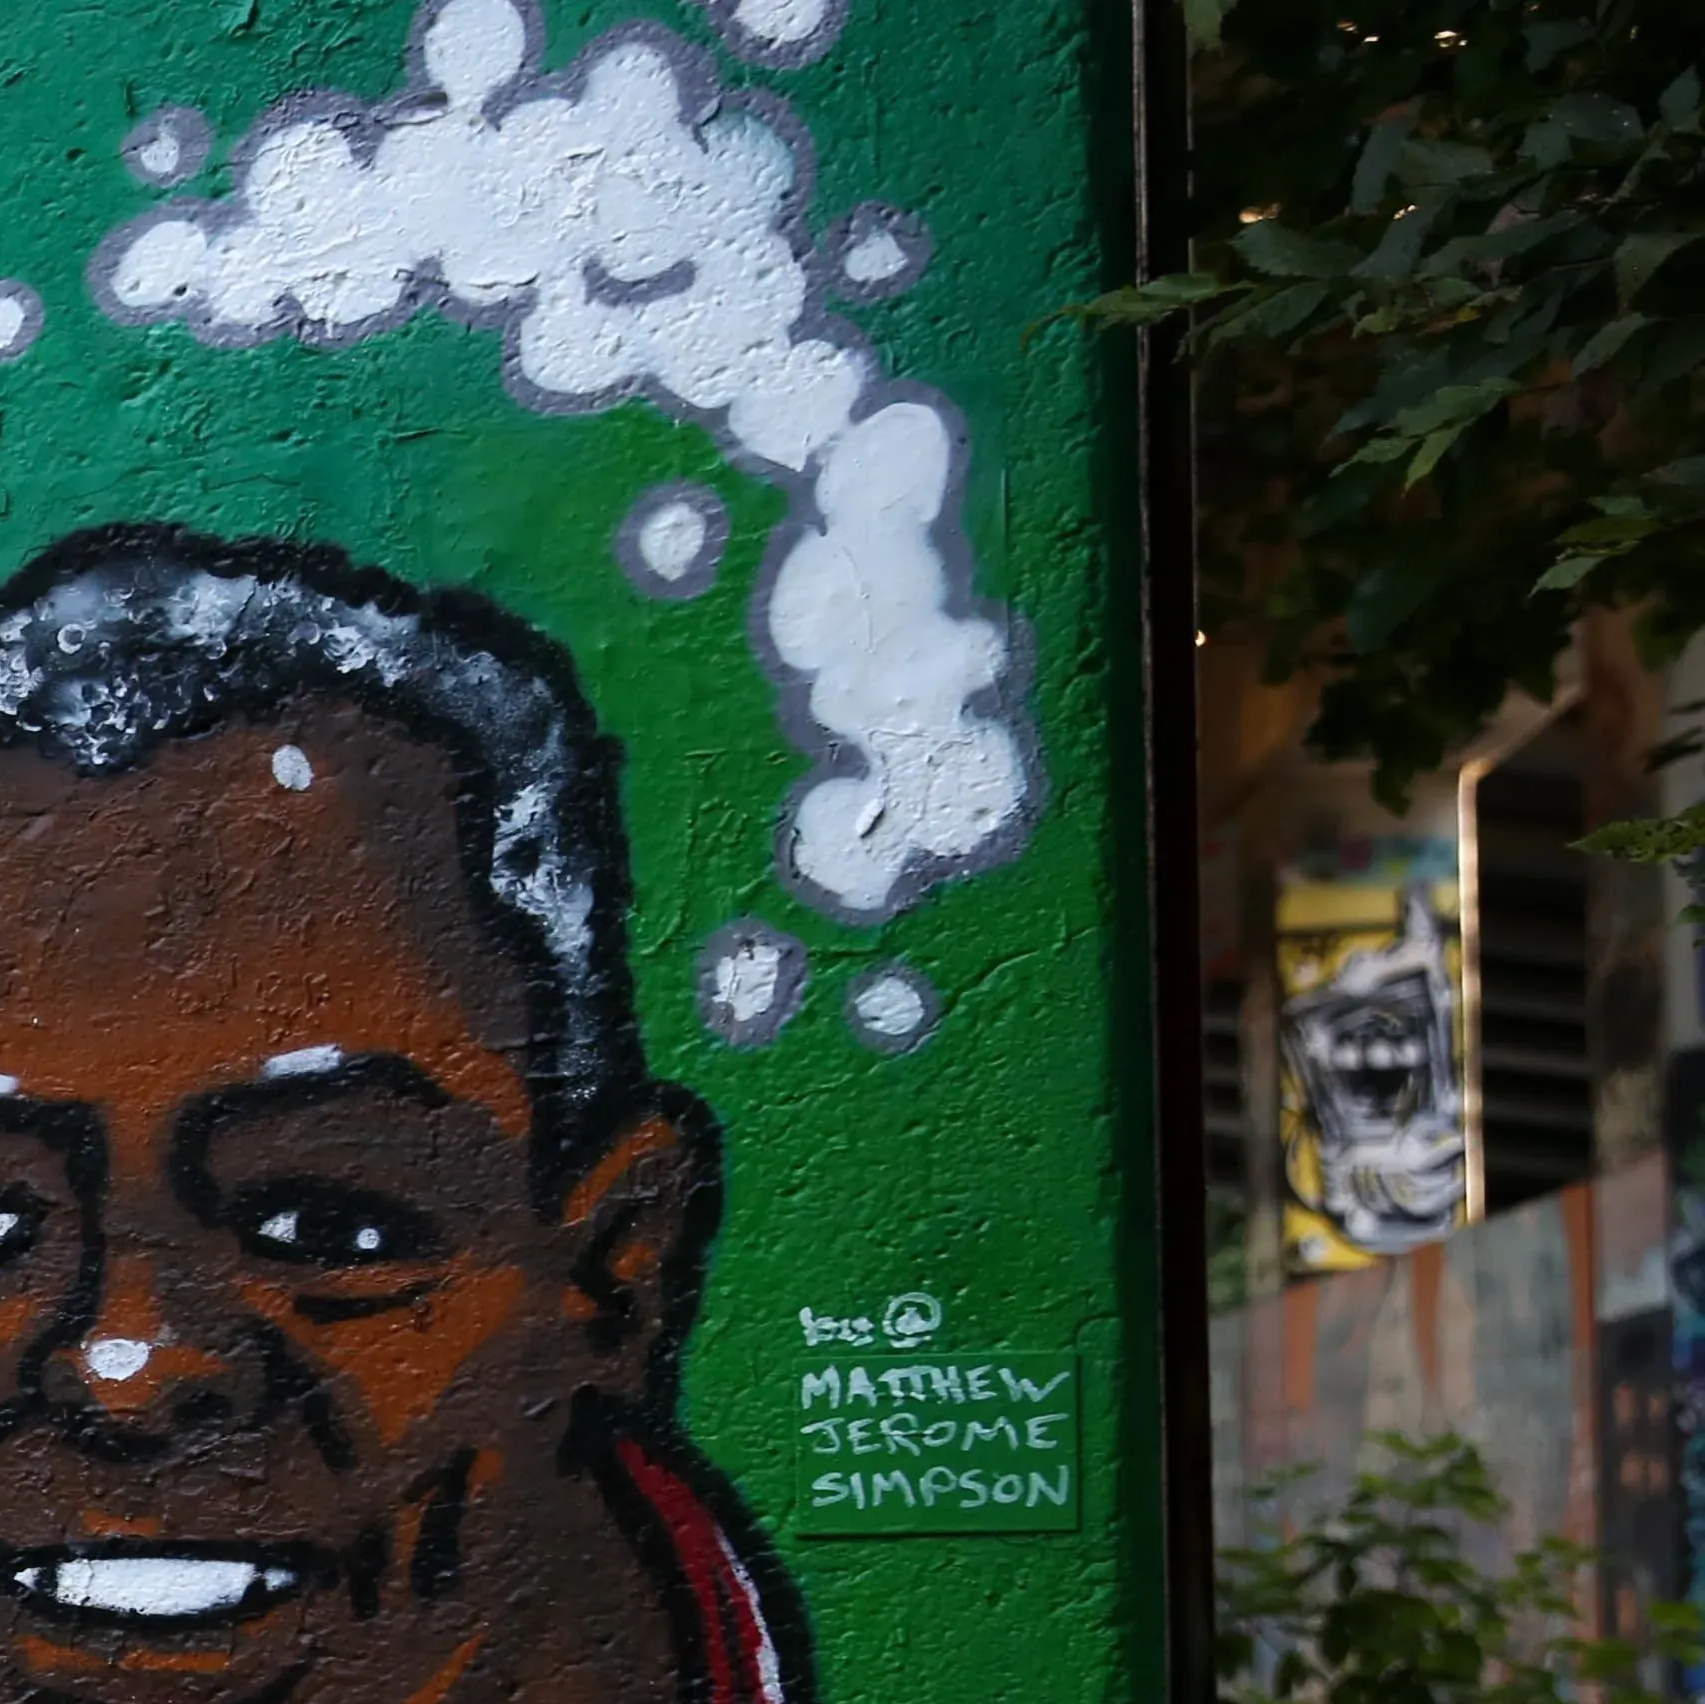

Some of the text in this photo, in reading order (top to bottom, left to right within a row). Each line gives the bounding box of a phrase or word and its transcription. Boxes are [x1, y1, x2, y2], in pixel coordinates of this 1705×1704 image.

[801, 1362, 1071, 1410] MATTHEW
[799, 1412, 1071, 1457] JEROME
[811, 1464, 1070, 1511] SIMPSON
